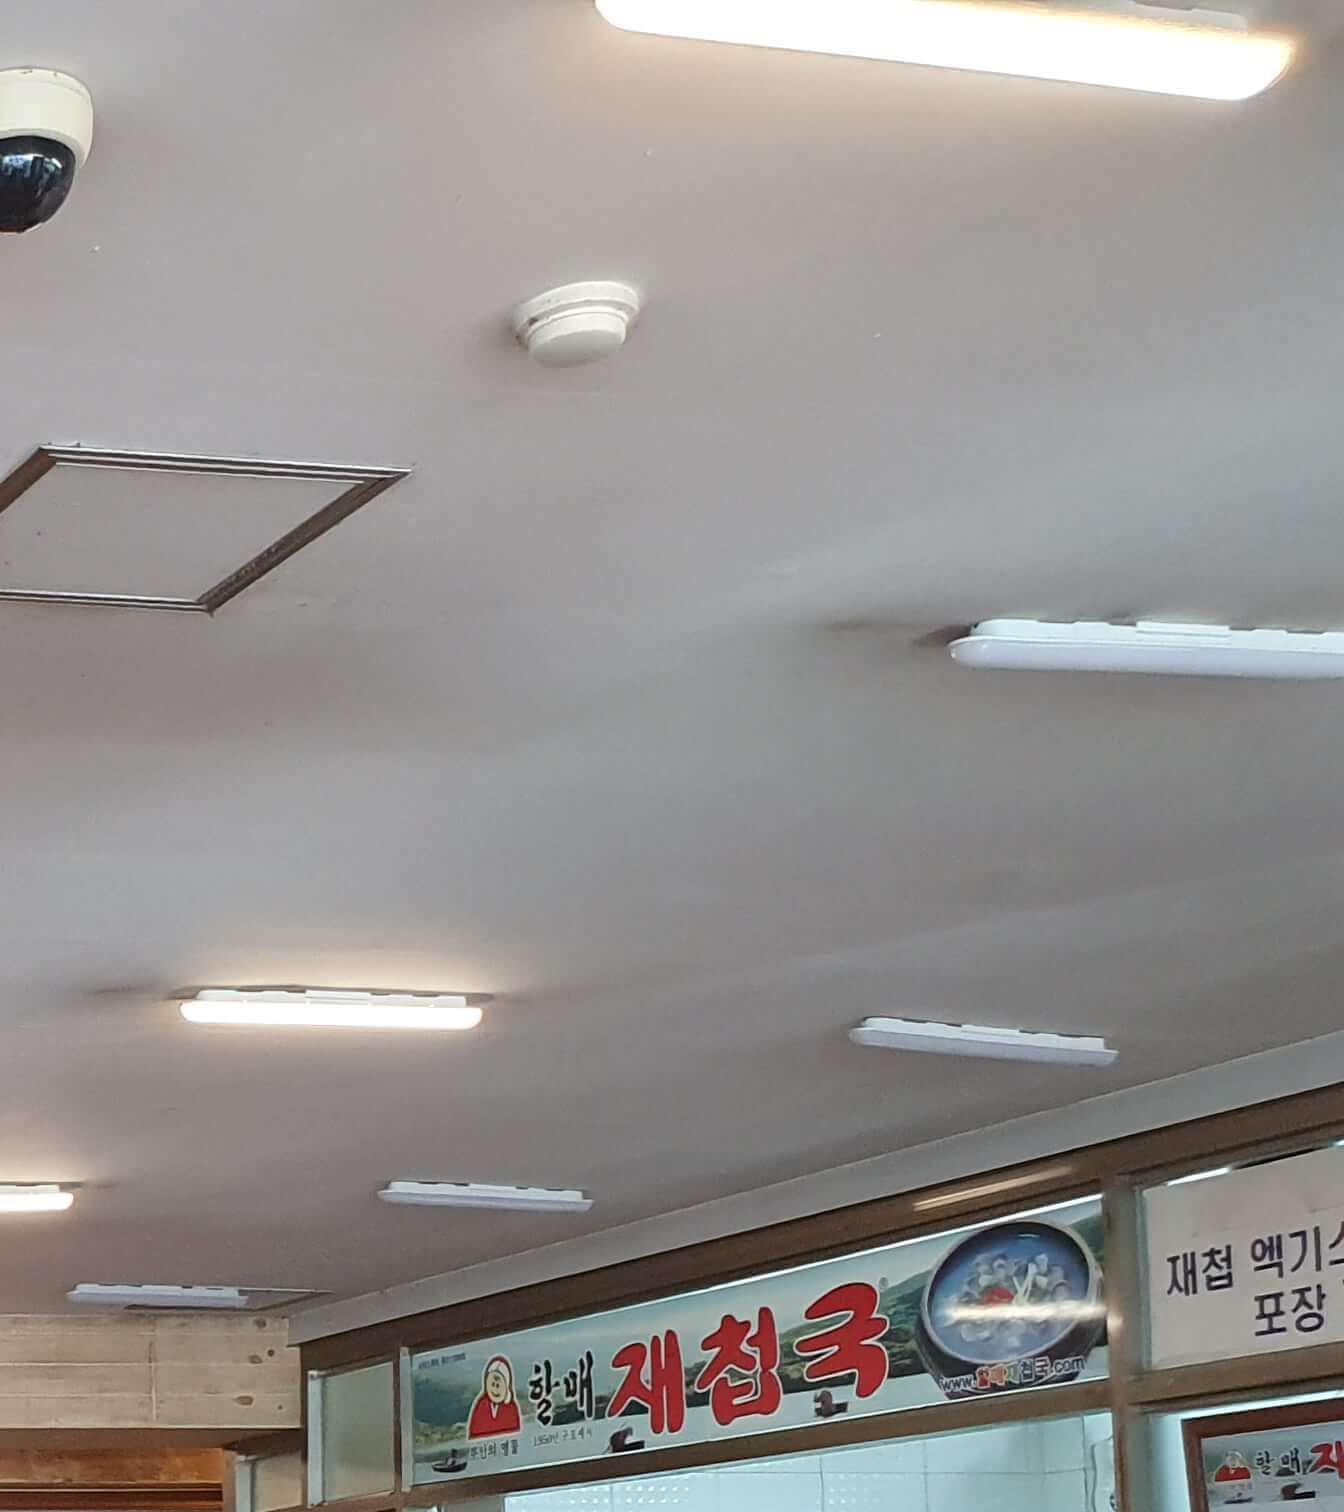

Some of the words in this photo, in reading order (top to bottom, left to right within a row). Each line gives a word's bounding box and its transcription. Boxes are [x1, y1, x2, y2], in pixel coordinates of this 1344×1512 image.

[1166, 1244, 1234, 1297] 재첩
[1254, 1283, 1327, 1337] 포장
[528, 1350, 595, 1426] 할매
[606, 1281, 889, 1434] 재첩국
[1255, 1447, 1301, 1476] 할매
